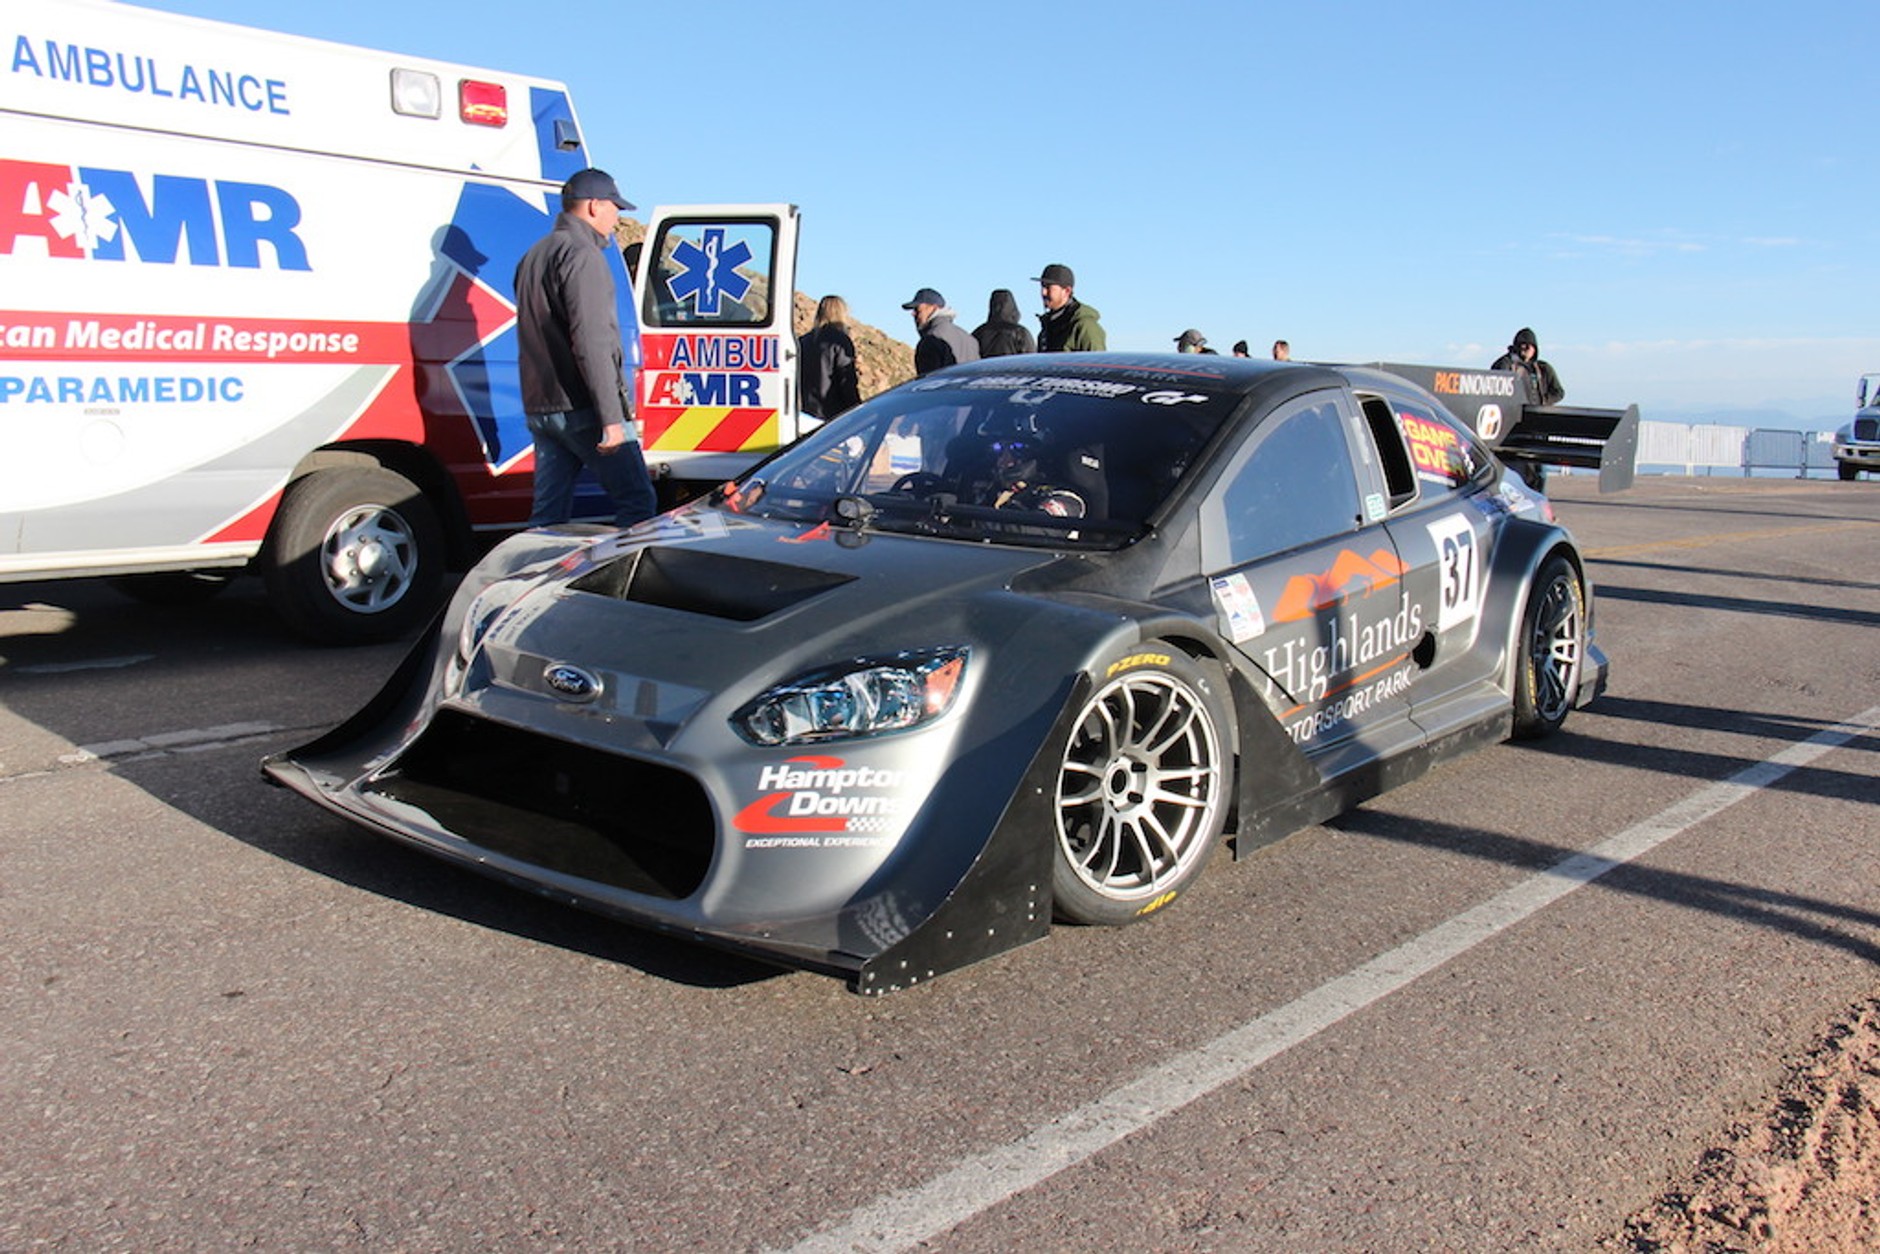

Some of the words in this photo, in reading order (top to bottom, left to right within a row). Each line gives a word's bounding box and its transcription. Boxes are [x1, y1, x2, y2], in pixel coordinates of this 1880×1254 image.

[11, 35, 290, 115] AMBULANCE
[0, 158, 313, 271] AMR
[64, 319, 203, 350] Medical
[212, 325, 359, 358] Response
[0, 376, 244, 403] PARAMEDIC
[648, 372, 762, 406] AMR
[1404, 418, 1458, 450] GAME
[1442, 530, 1474, 610] 37
[1264, 591, 1422, 702] Highlands
[1375, 665, 1412, 703] PARK
[745, 838, 822, 848] EXCEPTIONAL
